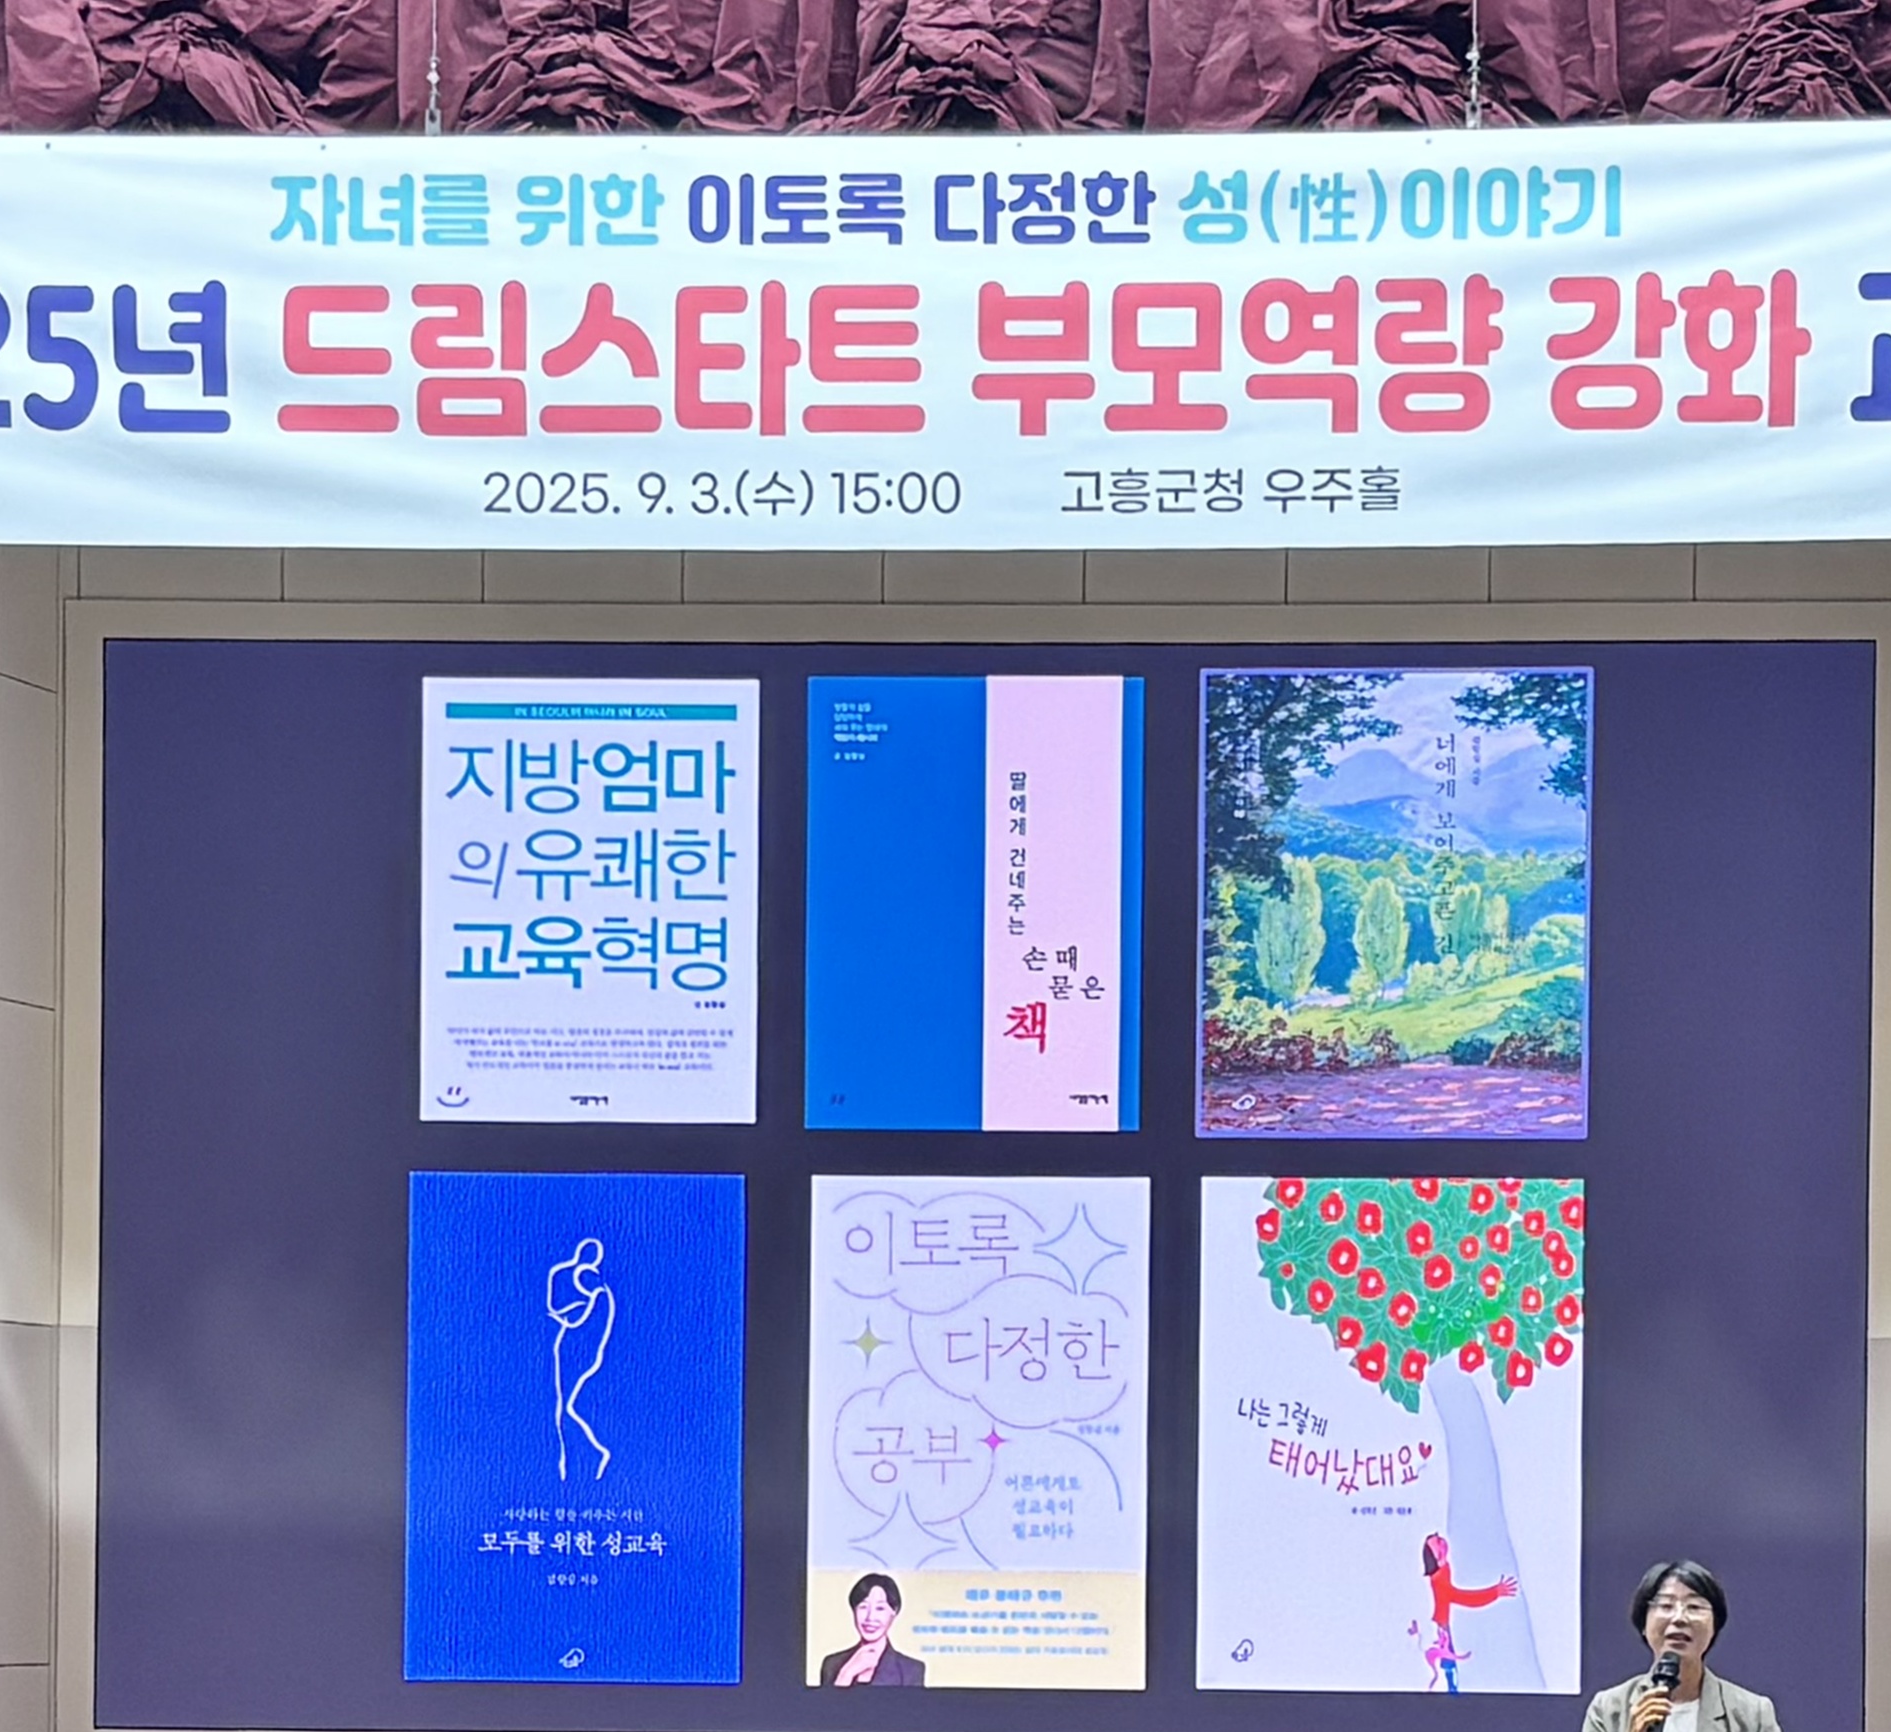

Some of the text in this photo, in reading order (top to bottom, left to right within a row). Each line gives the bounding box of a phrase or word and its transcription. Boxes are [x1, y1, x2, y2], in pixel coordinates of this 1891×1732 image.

[270, 164, 1622, 247] 자녀를 위한 이토록 다정한 성(性)이야기
[277, 280, 926, 437] 드림스타트
[972, 273, 1503, 436] 부모역량
[1547, 269, 1812, 431] 강화
[483, 471, 621, 515] 2025.
[637, 471, 674, 515] 9.
[830, 471, 961, 515] 15:00
[1060, 467, 1244, 514] 고흥군청
[1262, 465, 1401, 514] 우주홀
[445, 738, 737, 815] 지방엄마
[444, 915, 728, 992] 교육혁명
[1002, 1001, 1047, 1054] 책
[845, 1211, 1020, 1278] 이토록
[945, 1317, 1121, 1382] 다정한
[1237, 1397, 1328, 1438] 나는 그렇게
[852, 1426, 973, 1485] 공부
[1268, 1437, 1419, 1496] 태어났대요
[477, 1530, 668, 1557] 모두를 위한 성교육
